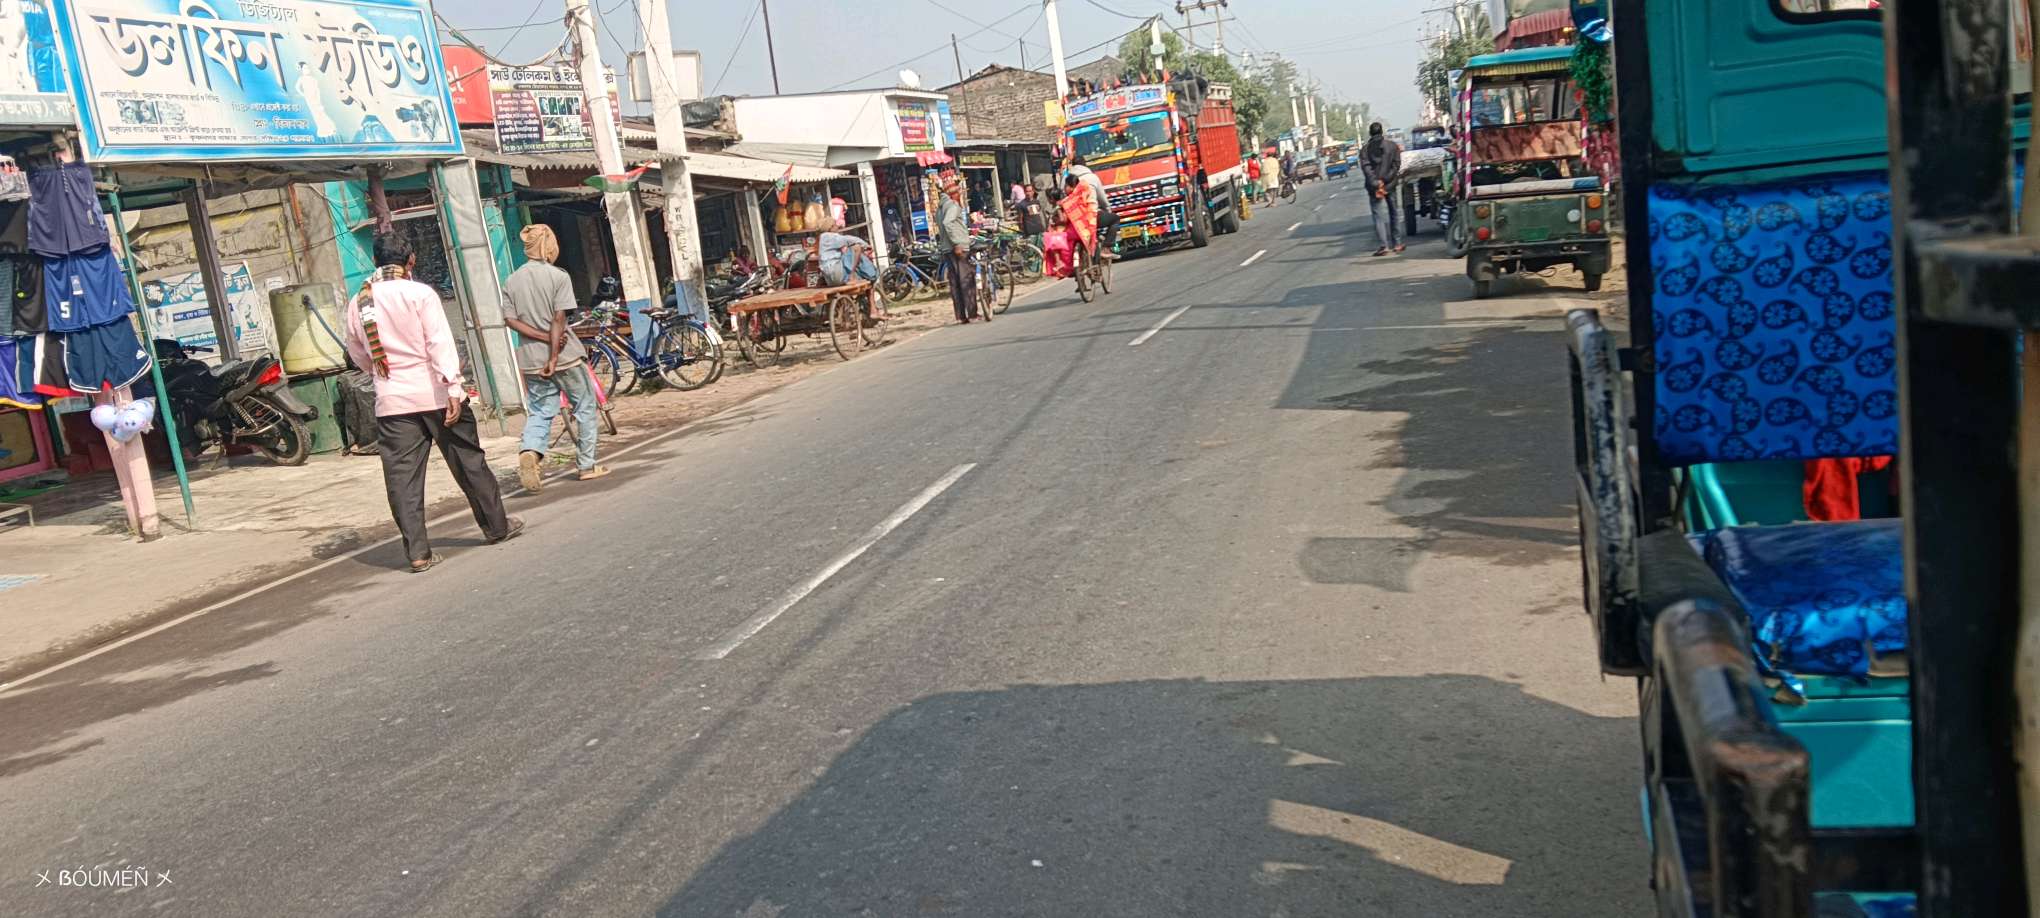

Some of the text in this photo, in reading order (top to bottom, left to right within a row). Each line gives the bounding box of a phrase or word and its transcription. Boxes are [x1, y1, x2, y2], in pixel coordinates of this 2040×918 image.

[91, 0, 288, 94] ডলফিন
[553, 70, 562, 82] ও
[60, 301, 71, 319] 5
